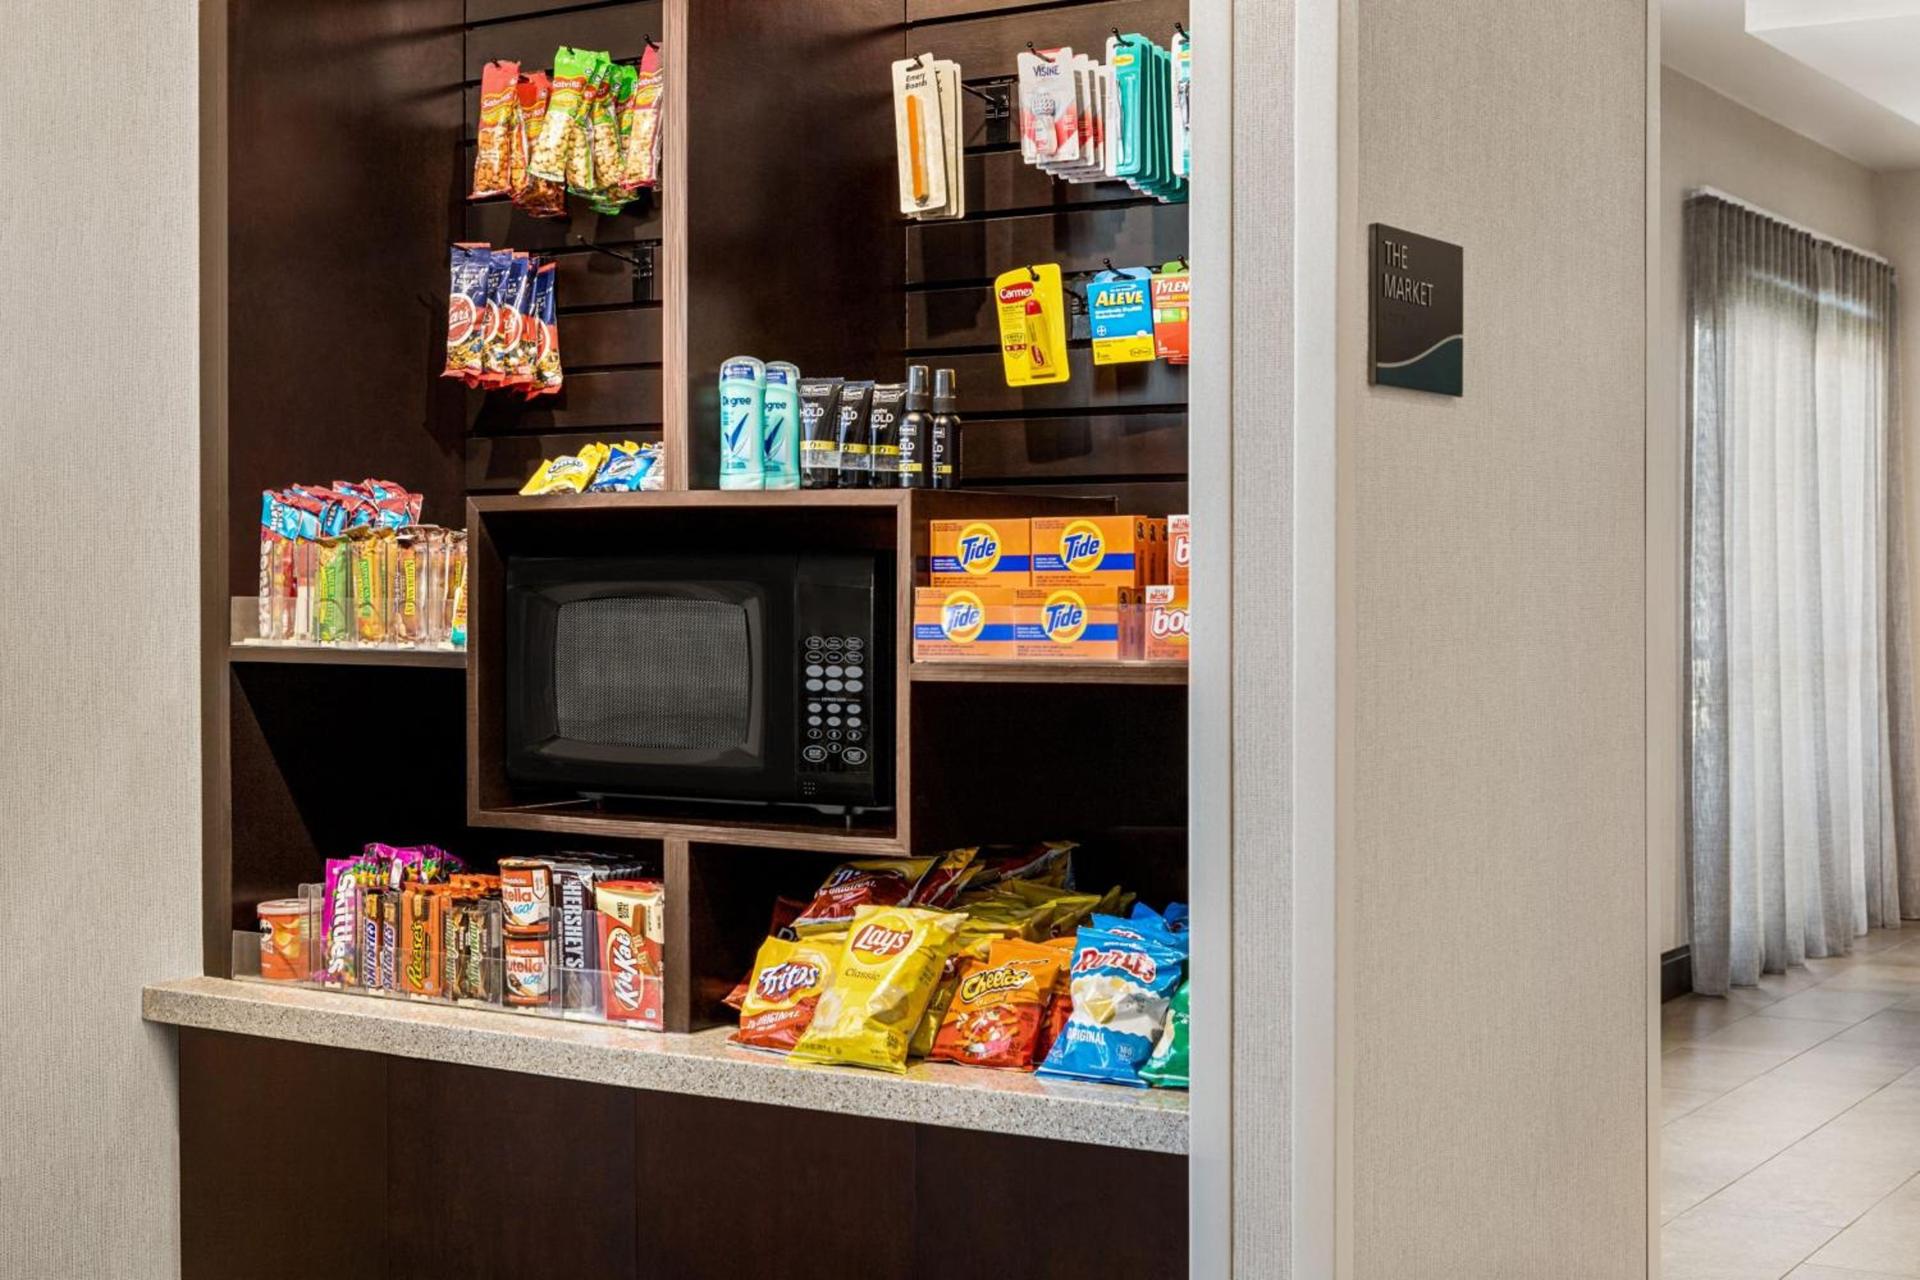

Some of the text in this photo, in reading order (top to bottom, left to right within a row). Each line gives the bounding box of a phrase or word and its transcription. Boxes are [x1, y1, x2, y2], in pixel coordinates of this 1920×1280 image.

[905, 80, 928, 91] Boards
[906, 72, 926, 83] Emery
[1033, 65, 1060, 77] VISINE
[1384, 240, 1409, 270] THE
[1095, 290, 1145, 307] ALEVE
[1384, 273, 1435, 306] MARKET
[900, 442, 915, 451] OLD
[961, 536, 997, 565] Tide
[1064, 535, 1100, 565] Tide
[945, 604, 982, 633] Tide
[1045, 604, 1082, 633] Tide
[503, 887, 532, 902] tella
[328, 873, 356, 974] Skittles
[563, 879, 585, 969] HERSHEY'S
[406, 921, 424, 989] Reese's
[506, 958, 545, 973] utella
[758, 962, 820, 995] Fritos
[845, 967, 881, 981] Classic
[962, 968, 1030, 1001] Cheetos
[1066, 1026, 1106, 1046] ORIGINAL
